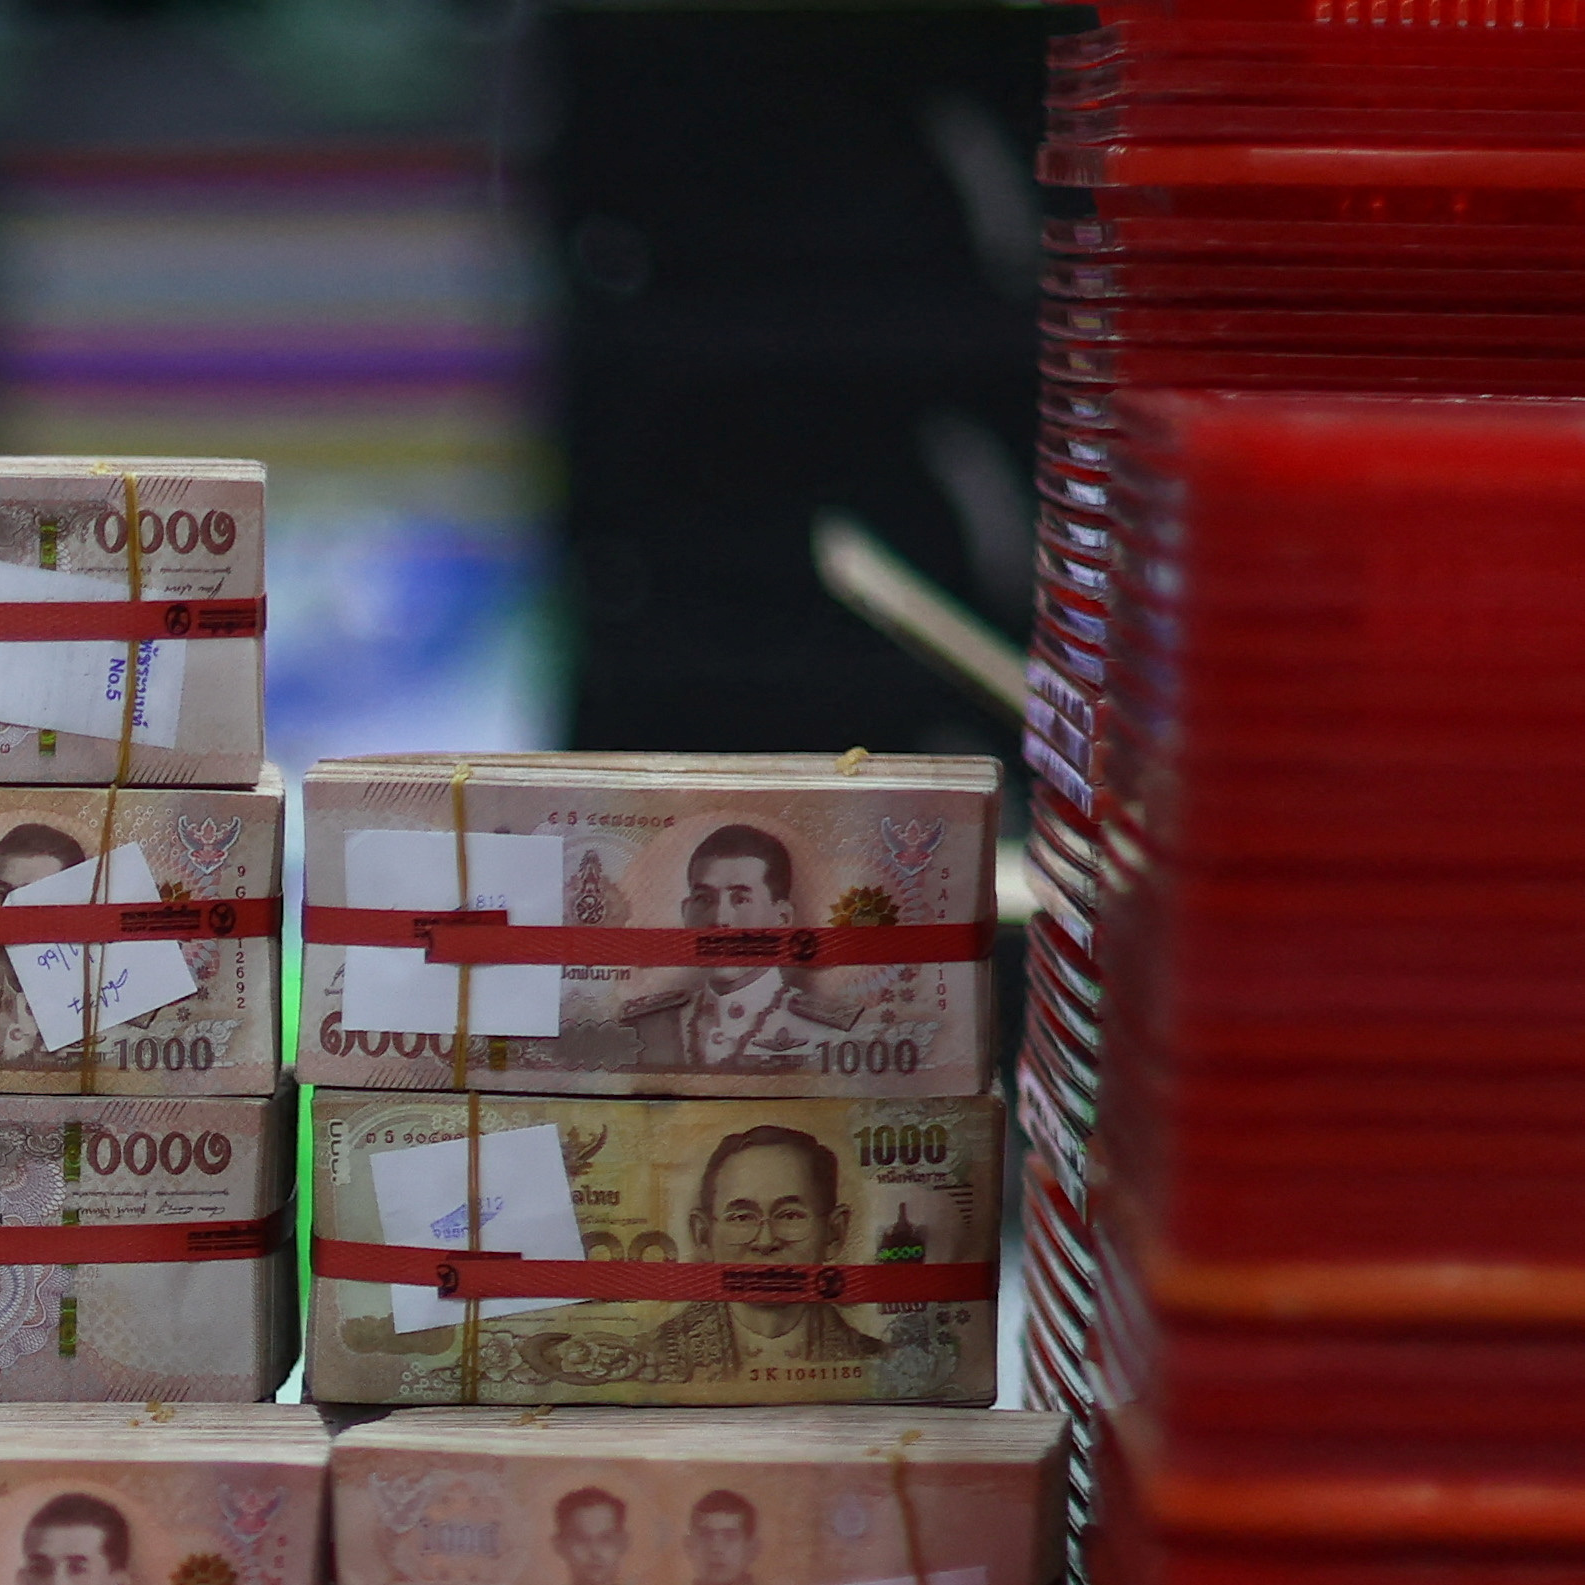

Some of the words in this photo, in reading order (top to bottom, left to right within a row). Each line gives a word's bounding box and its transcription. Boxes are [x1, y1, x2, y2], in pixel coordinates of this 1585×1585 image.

[93, 508, 238, 556] ๑๐๐๐
[105, 657, 127, 702] No.5
[113, 1037, 216, 1072] 1000
[817, 1039, 919, 1075] 1000
[87, 1130, 232, 1176] ๑๐๐๐
[853, 1123, 949, 1168] 1000
[786, 1366, 863, 1382] 1041186
